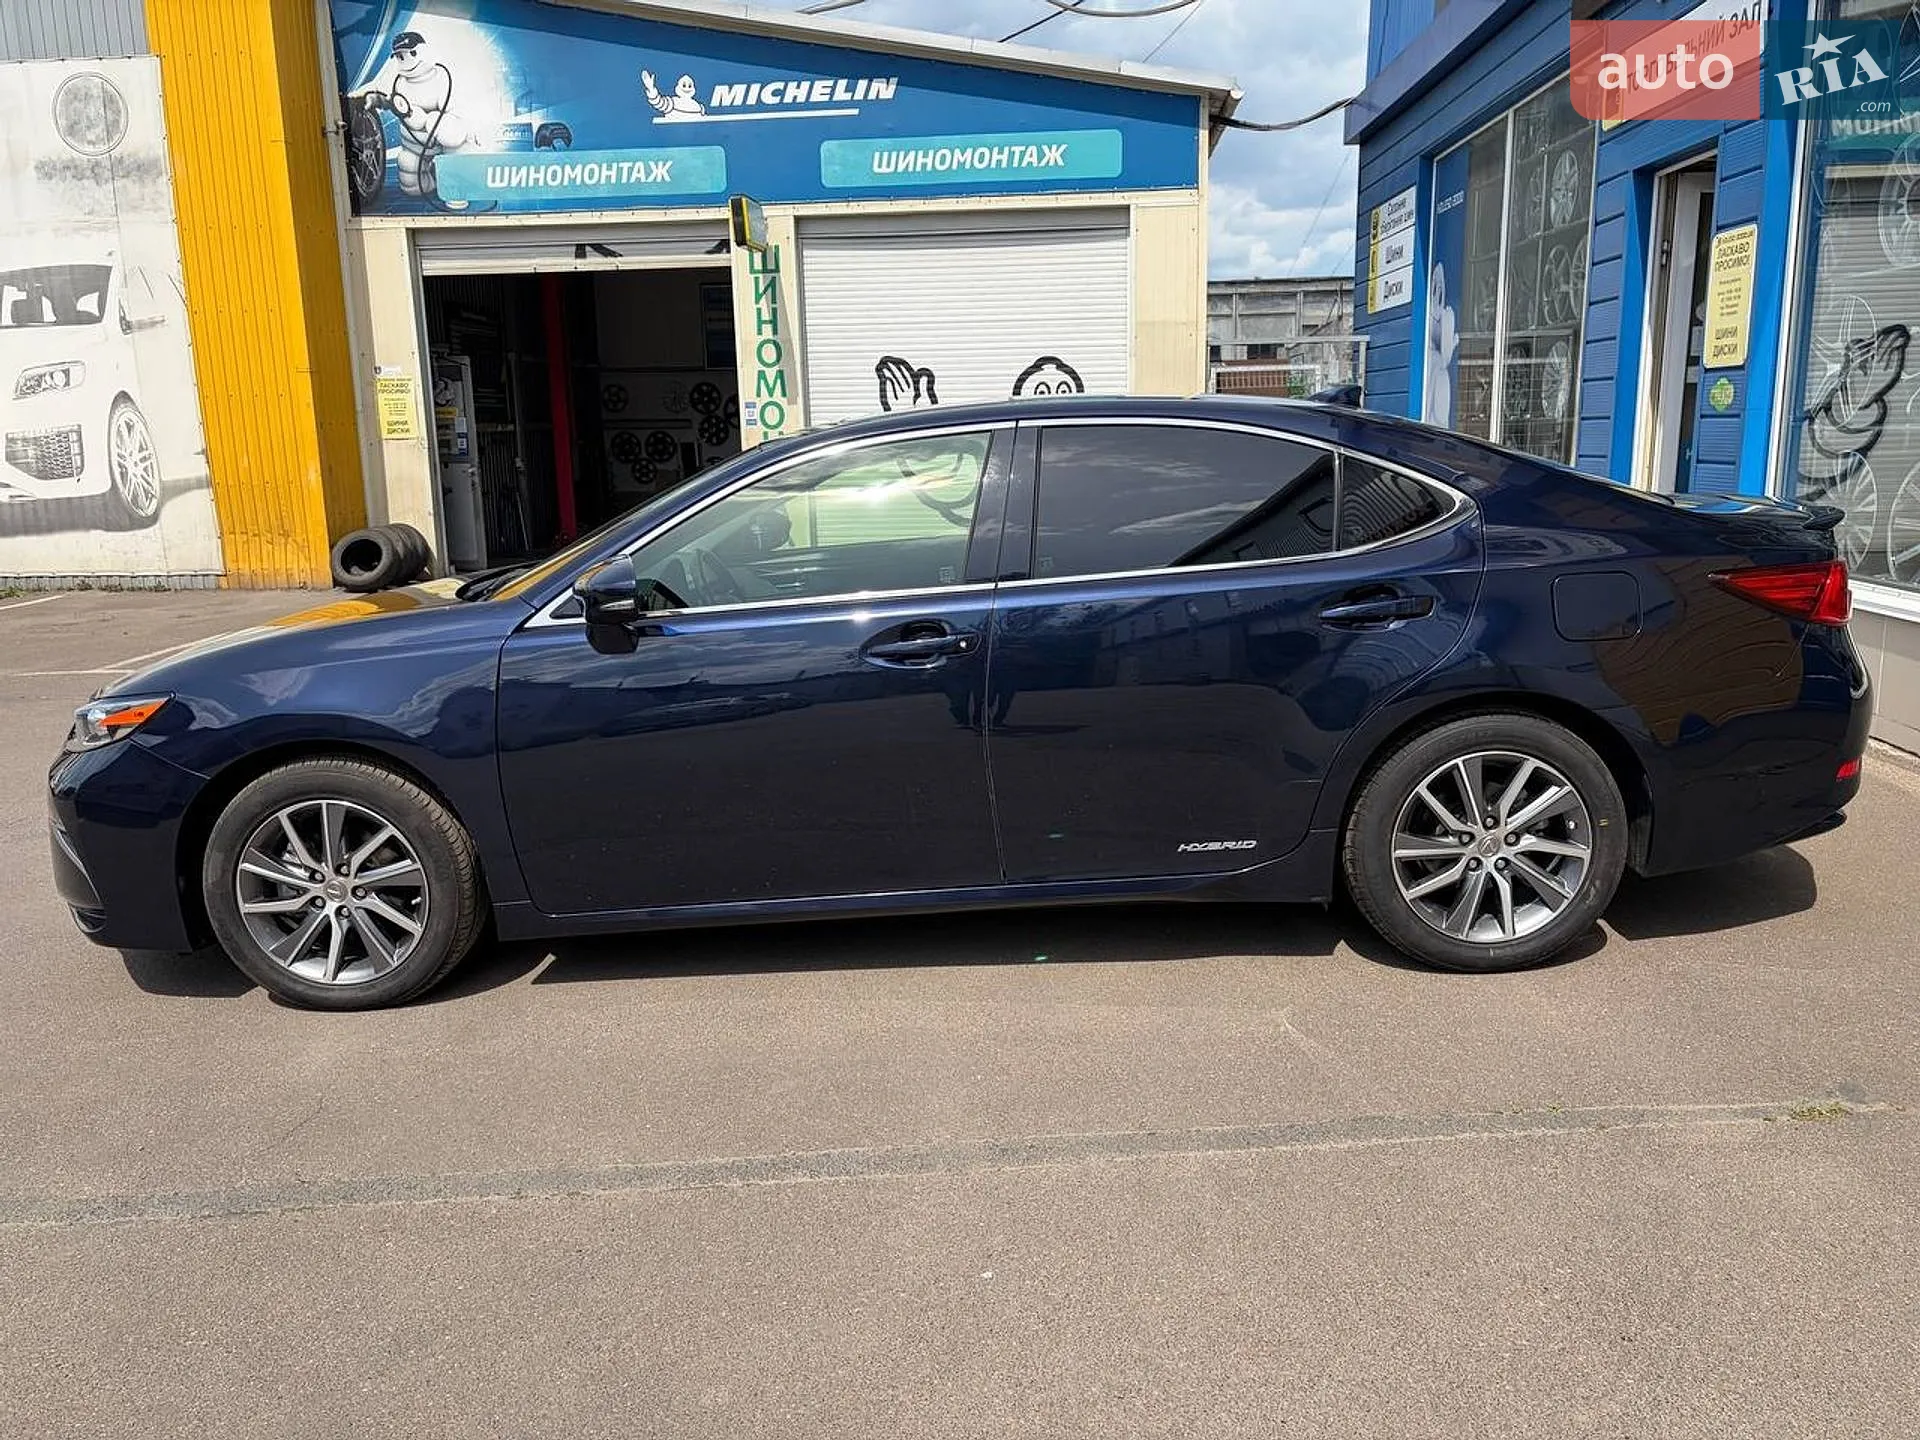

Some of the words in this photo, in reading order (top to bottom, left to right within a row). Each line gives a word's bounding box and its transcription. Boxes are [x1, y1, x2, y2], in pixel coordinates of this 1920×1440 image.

[709, 77, 898, 107] MICHELIN
[872, 143, 1068, 174] ШИНОМОНТАЖ
[486, 160, 673, 188] ШИНОМОНТАЖ
[748, 244, 788, 441] ШИНОМО
[1177, 840, 1257, 852] HYBRID
